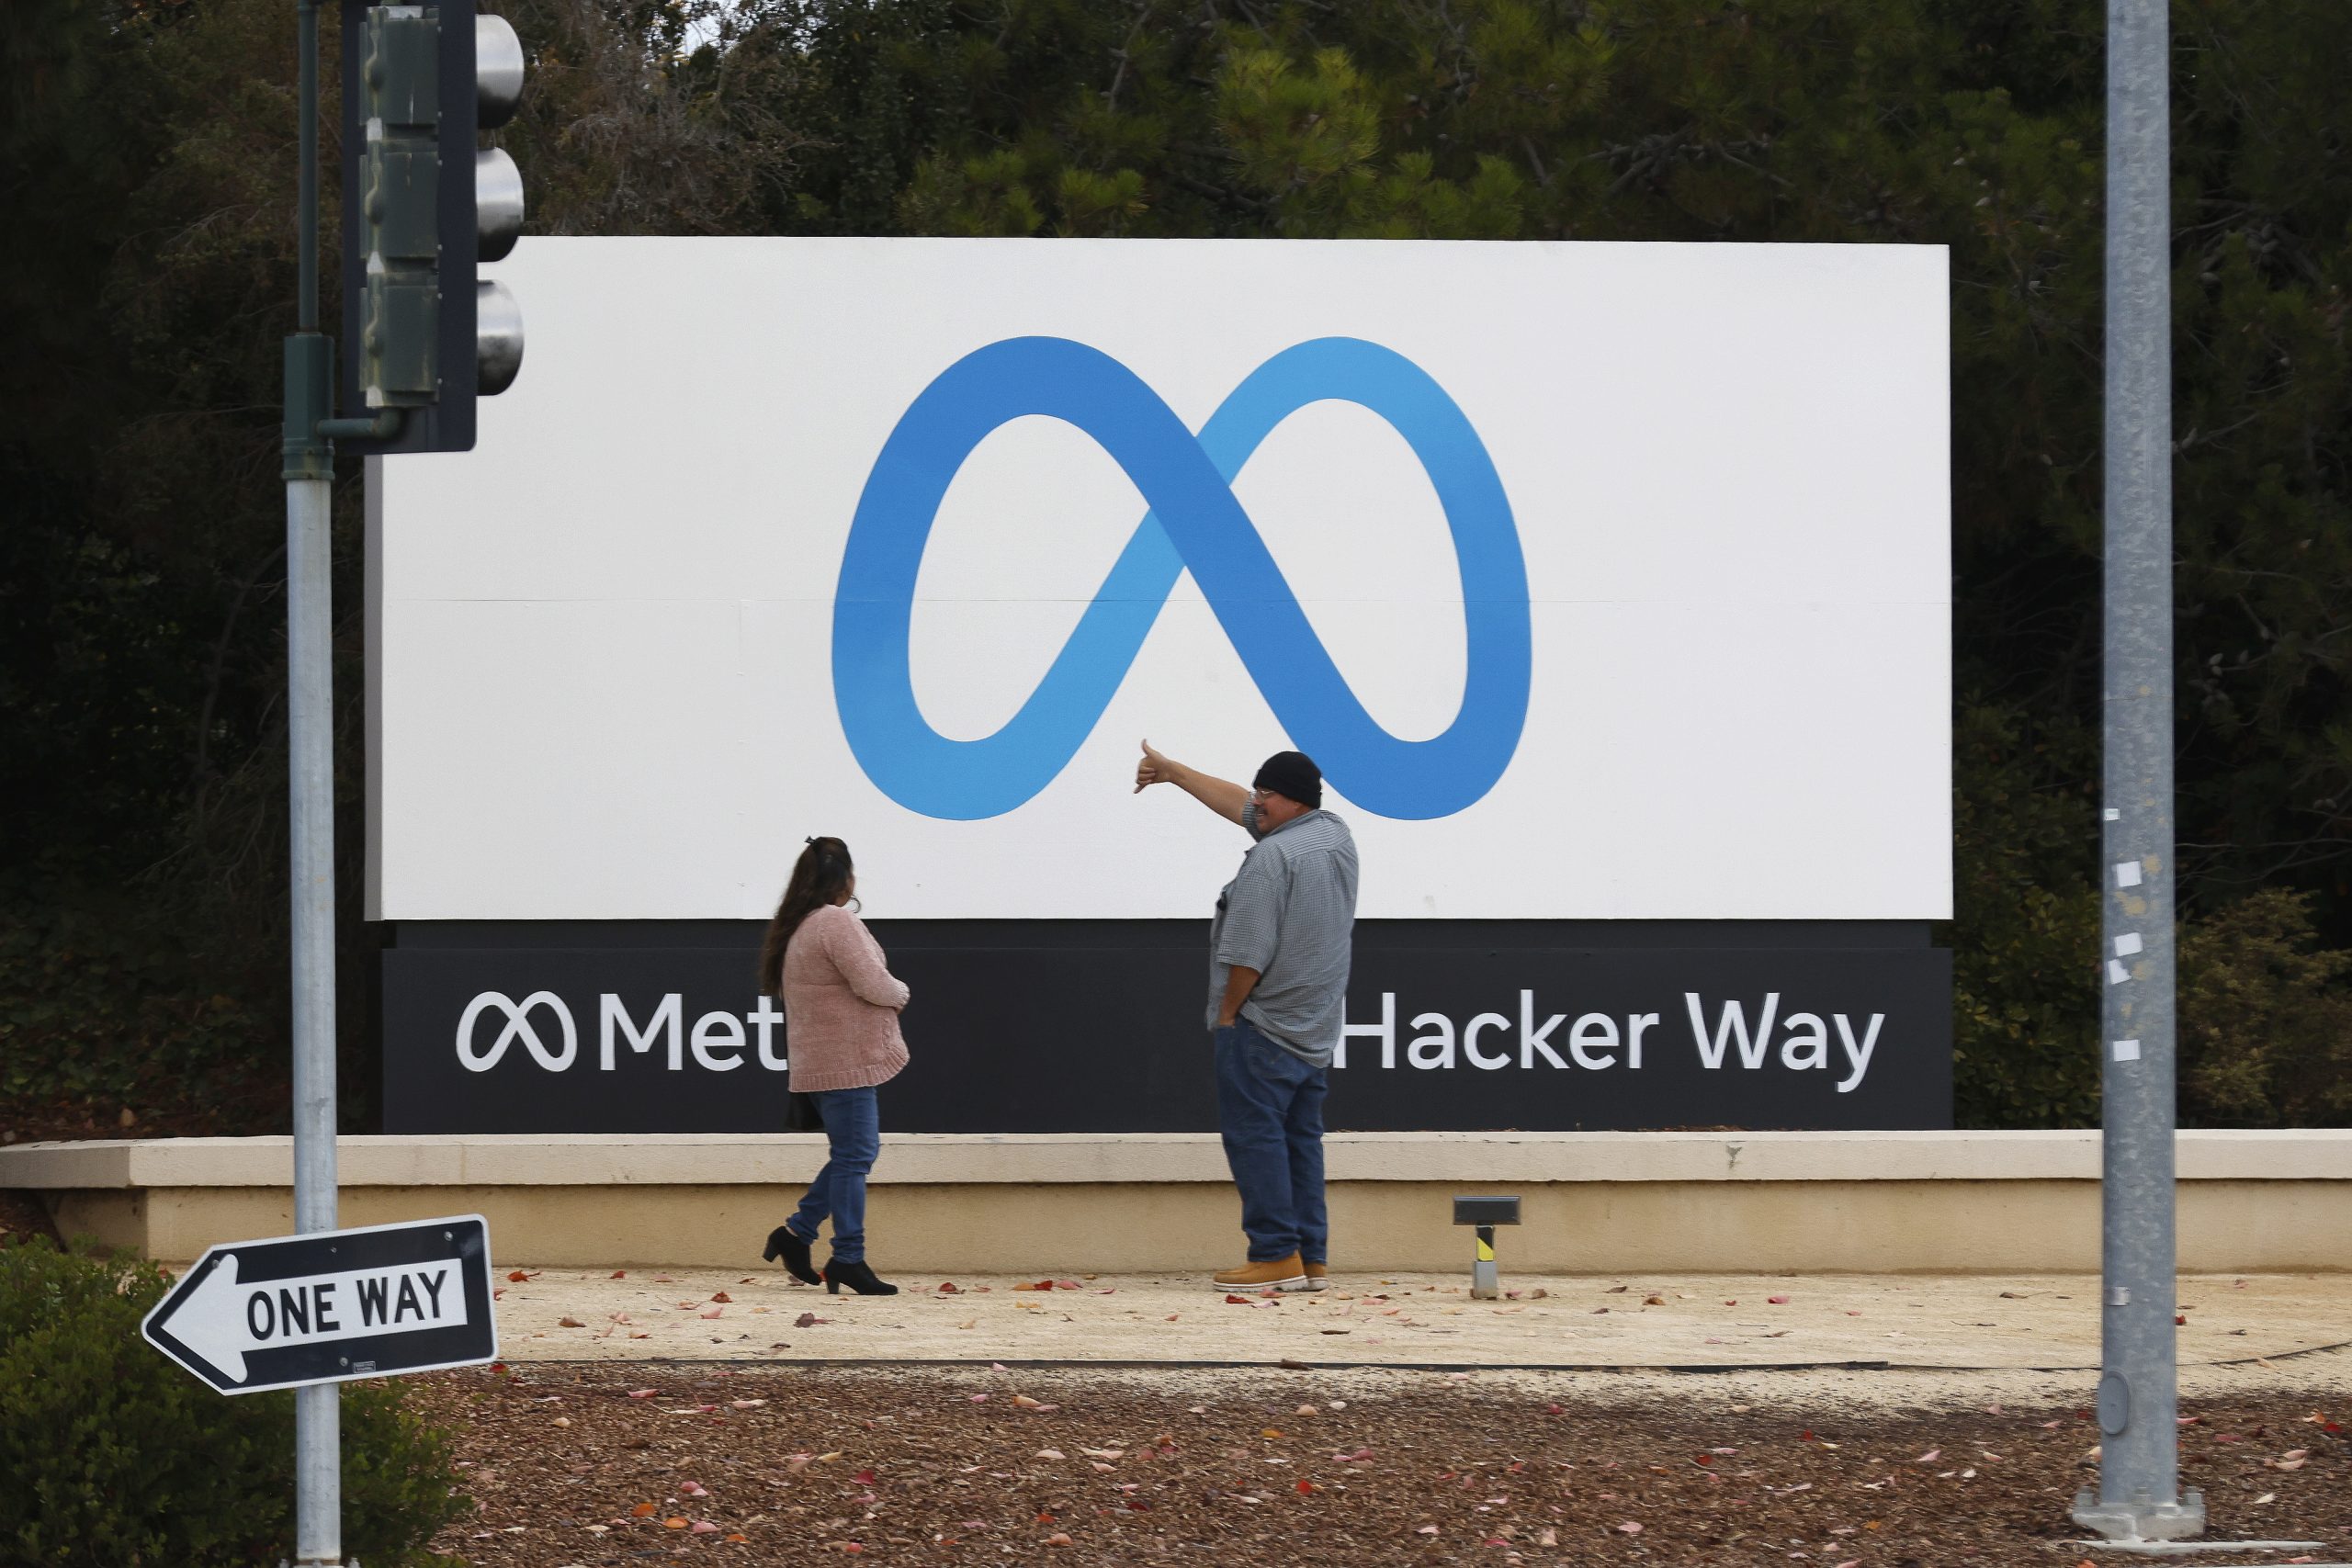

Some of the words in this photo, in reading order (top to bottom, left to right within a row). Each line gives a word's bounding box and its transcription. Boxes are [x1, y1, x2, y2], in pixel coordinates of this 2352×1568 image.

[600, 993, 788, 1072] Met
[1333, 988, 1660, 1070] Hacker
[1684, 992, 1885, 1093] Way
[247, 1282, 341, 1341] ONE
[356, 1269, 447, 1327] WAY
